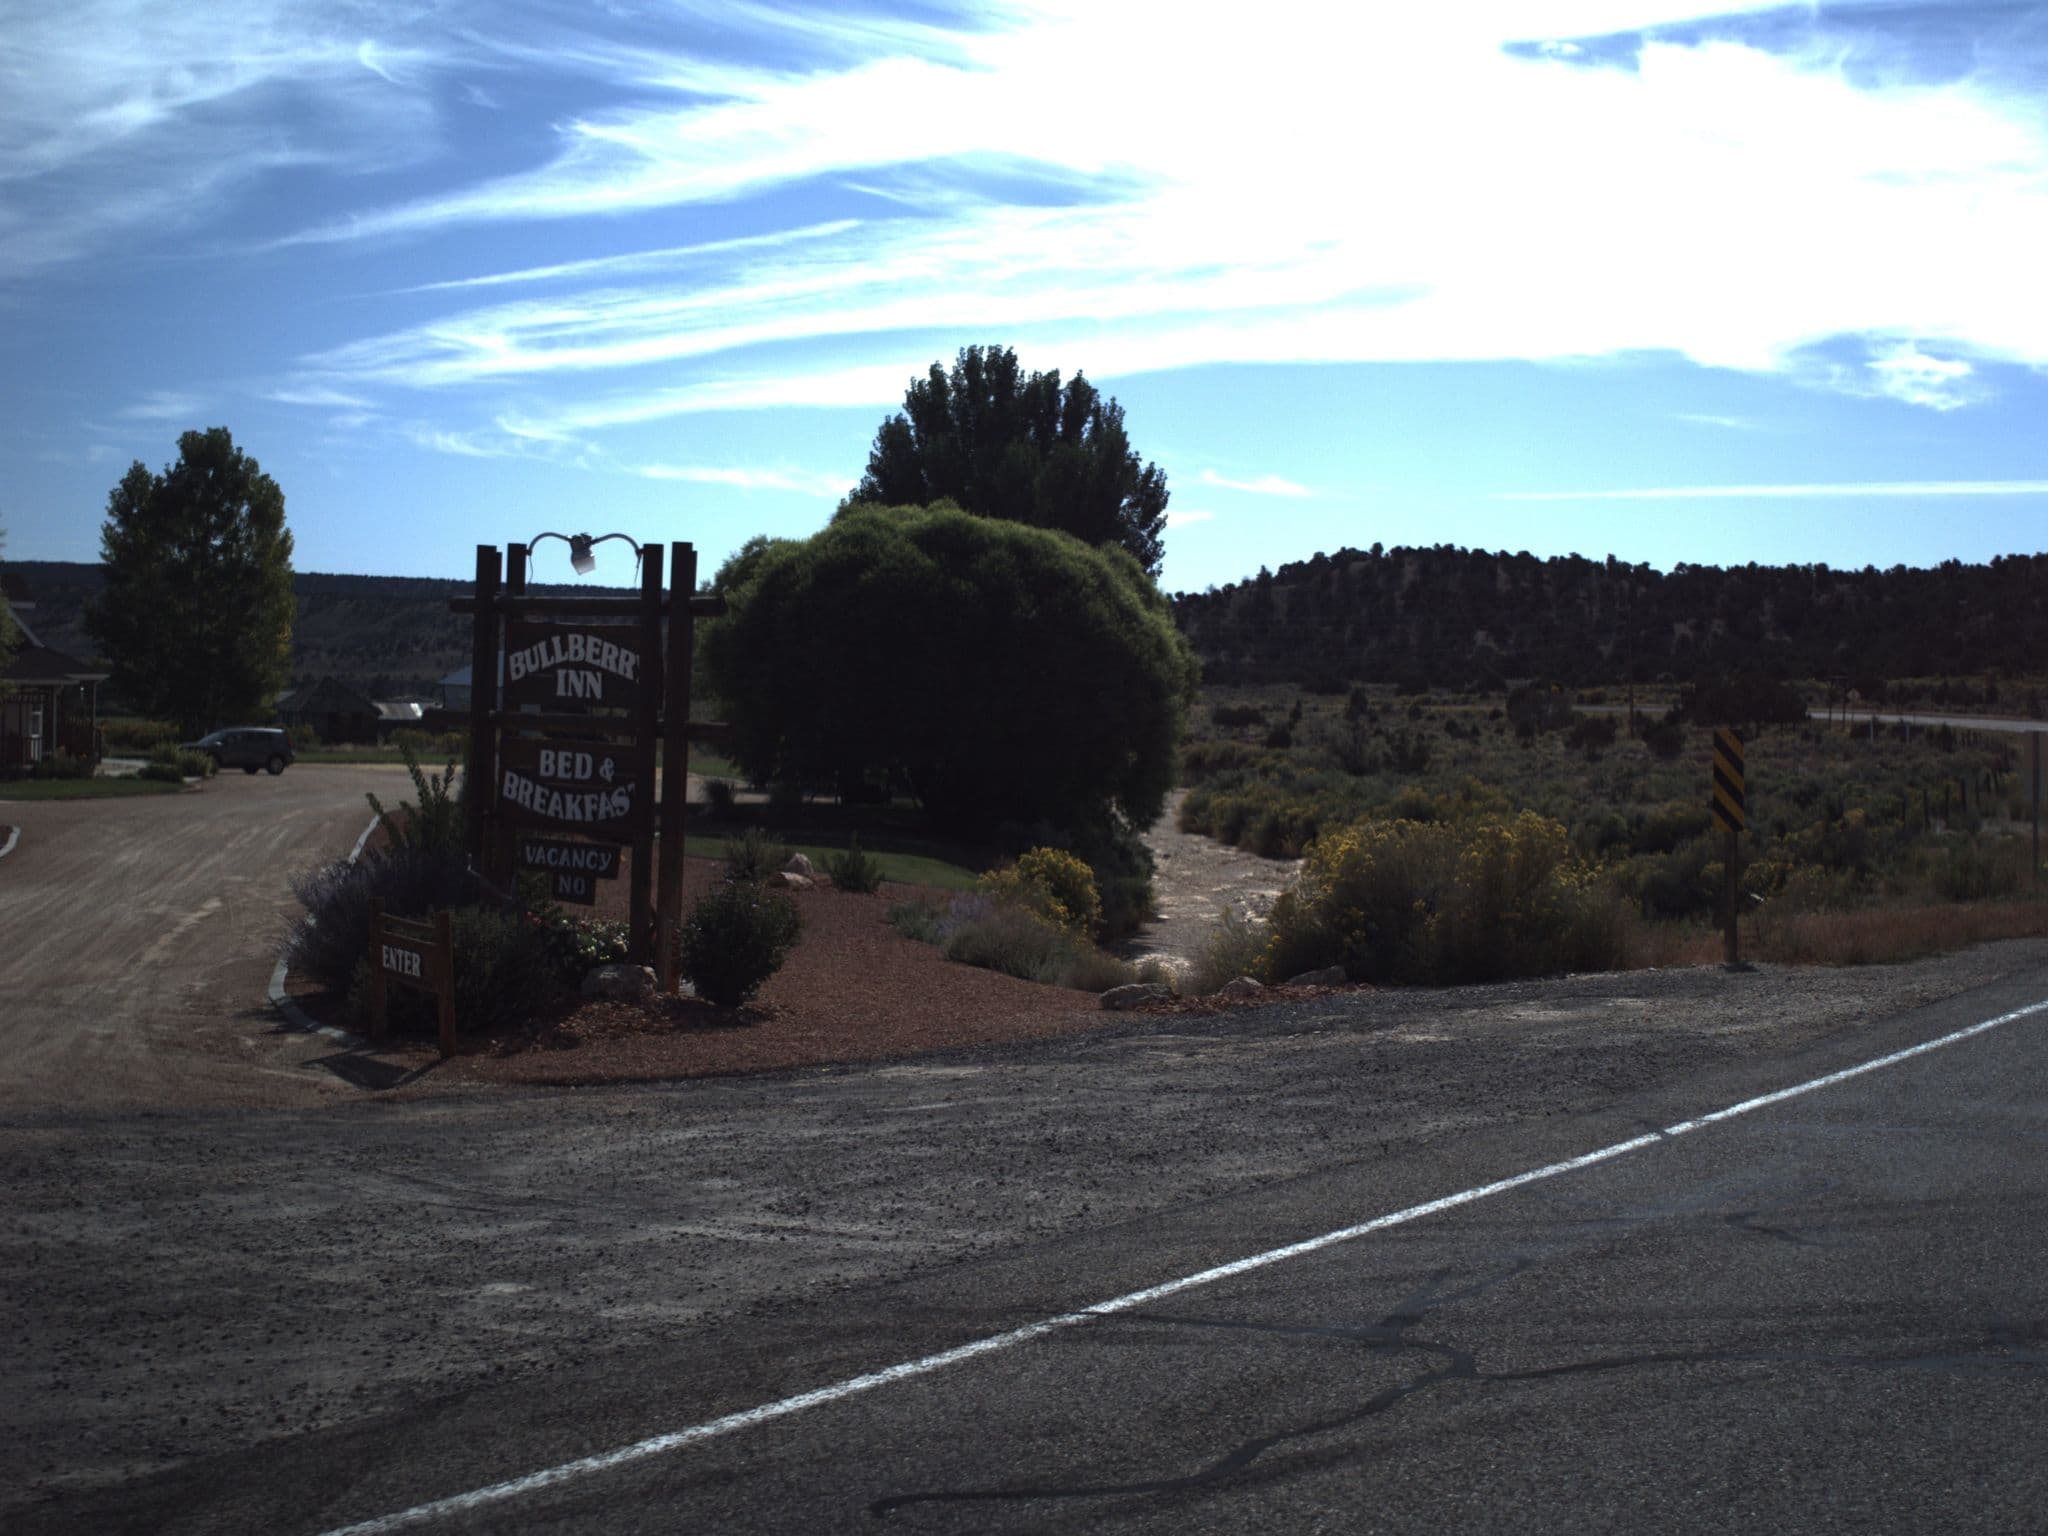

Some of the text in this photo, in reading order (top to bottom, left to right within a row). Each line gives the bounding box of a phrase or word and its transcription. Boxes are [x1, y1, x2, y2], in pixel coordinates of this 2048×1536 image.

[556, 668, 603, 699] INN
[539, 749, 616, 783] BED &
[502, 770, 636, 822] BREAKFAS
[525, 845, 613, 872] VACANCY
[558, 874, 586, 895] NO
[382, 944, 422, 977] ENTER
